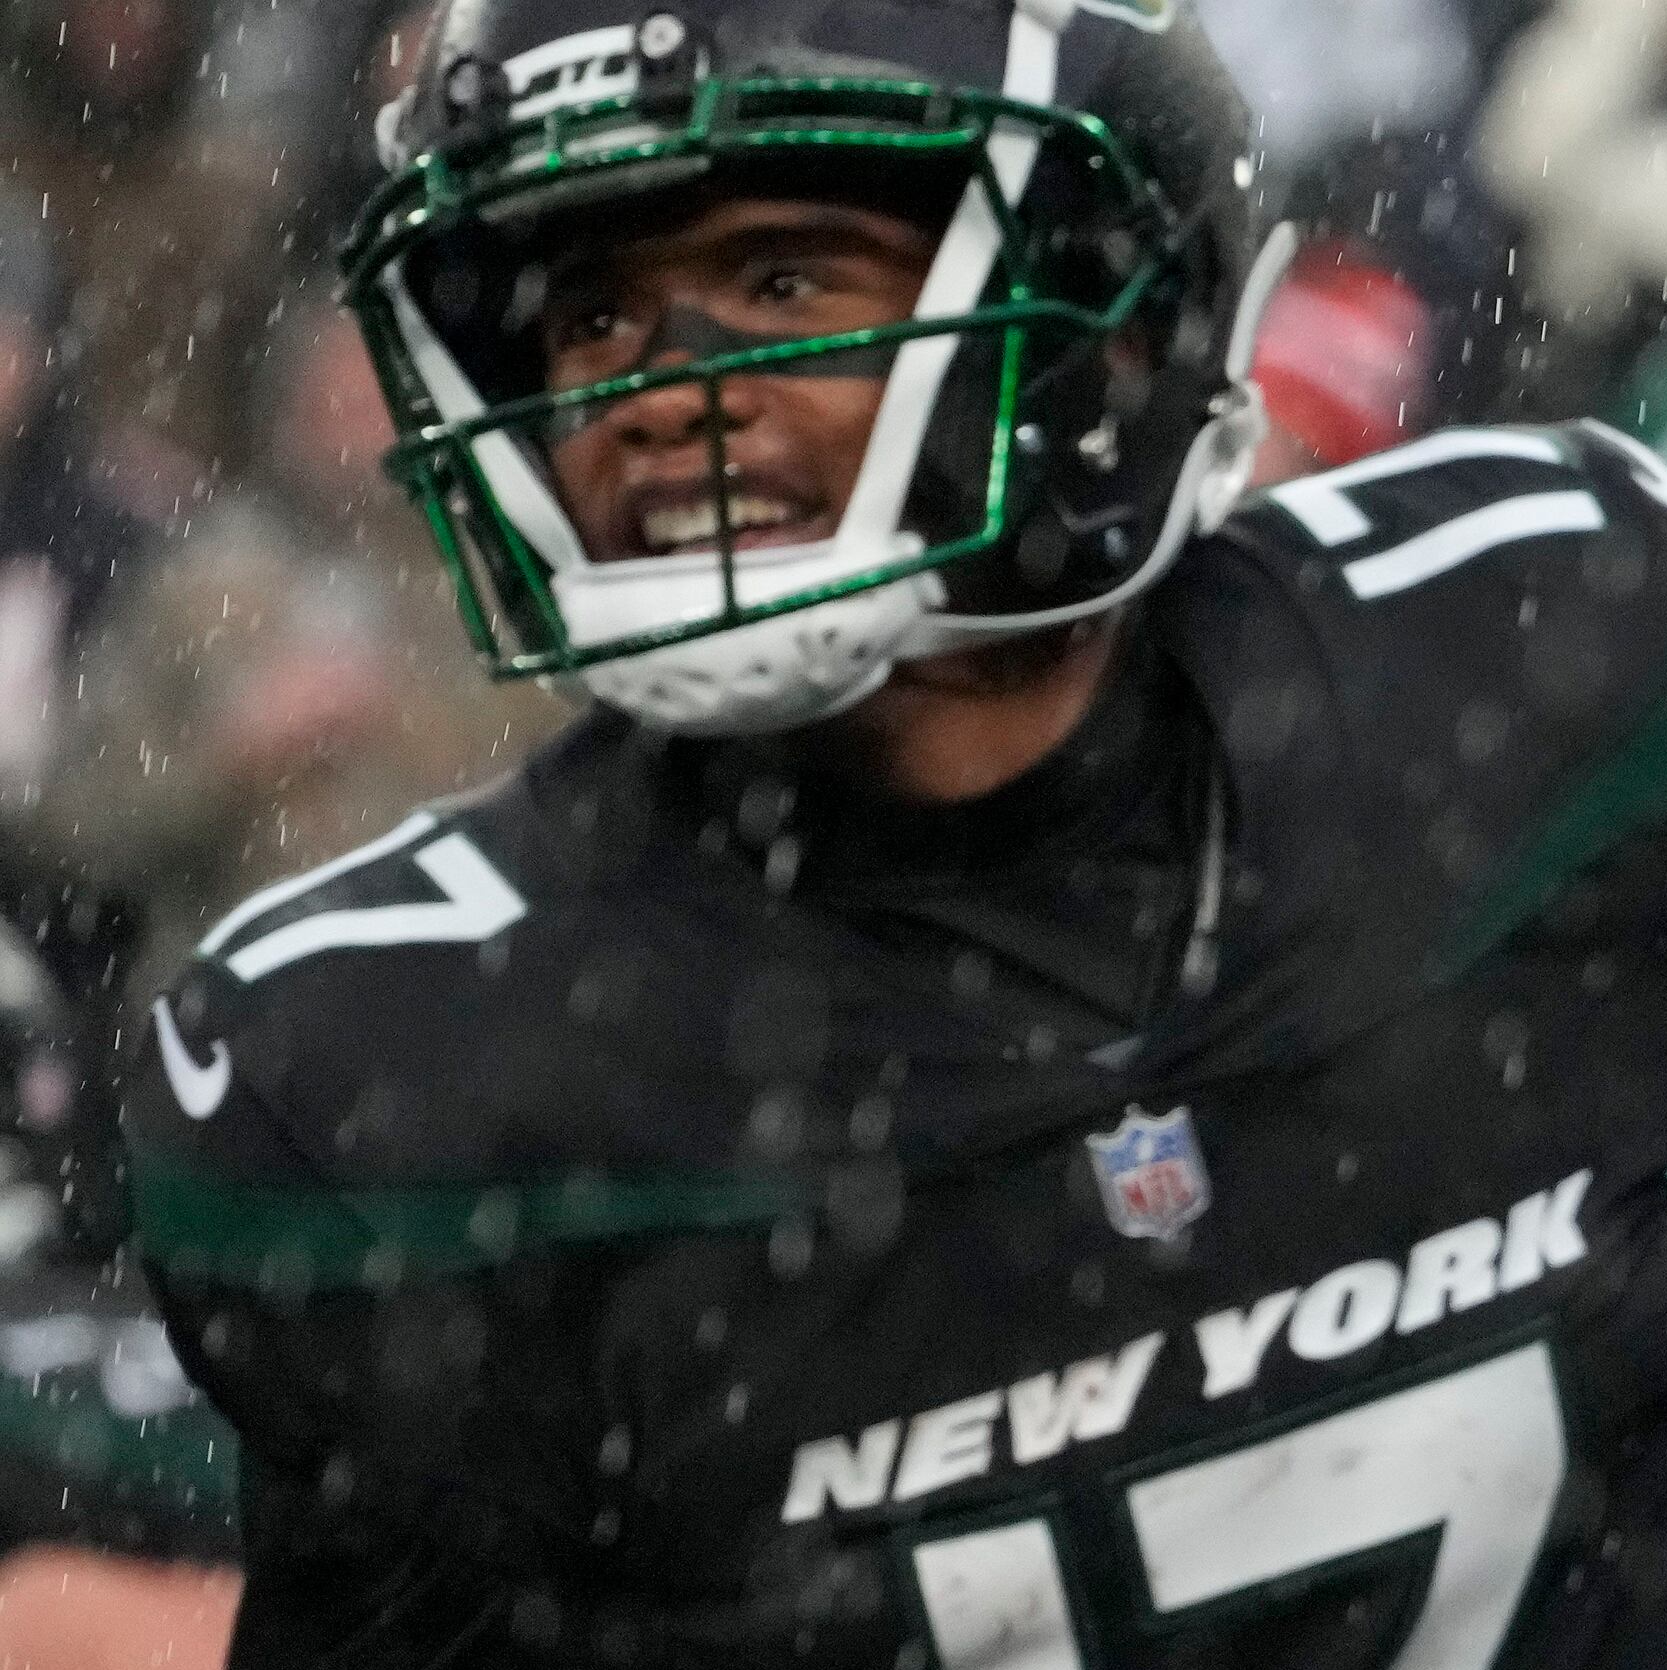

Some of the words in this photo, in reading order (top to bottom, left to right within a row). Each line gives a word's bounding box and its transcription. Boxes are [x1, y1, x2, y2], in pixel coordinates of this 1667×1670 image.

[197, 809, 528, 983] 17
[783, 1333, 1167, 1524] NEW
[1195, 1168, 1593, 1399] YORK
